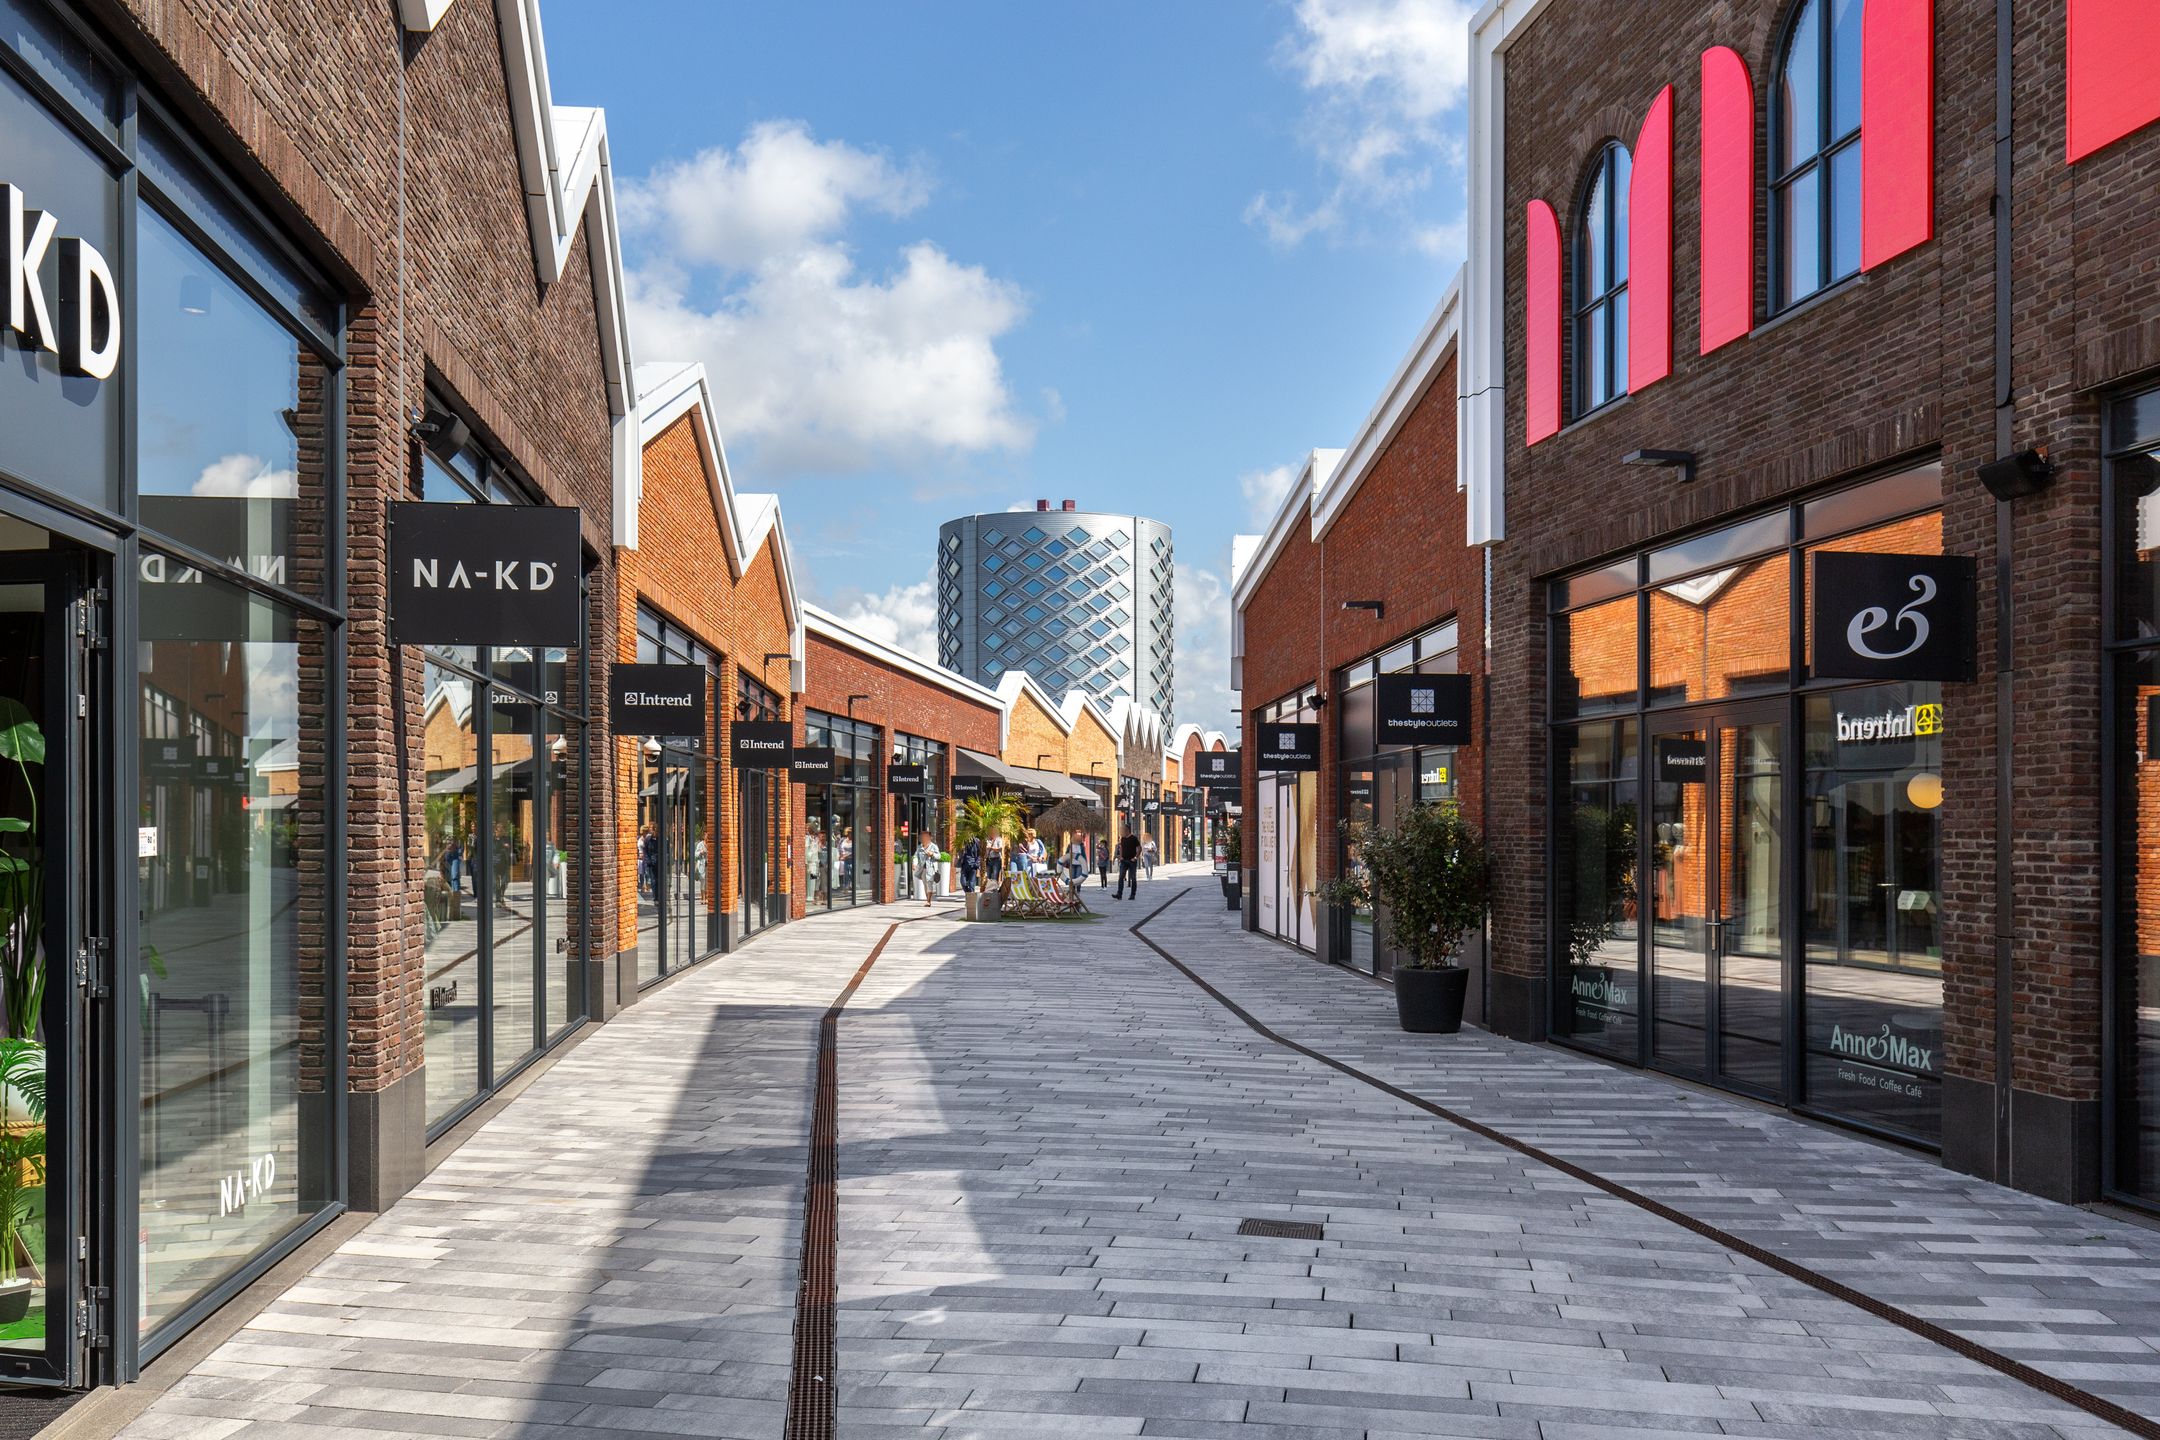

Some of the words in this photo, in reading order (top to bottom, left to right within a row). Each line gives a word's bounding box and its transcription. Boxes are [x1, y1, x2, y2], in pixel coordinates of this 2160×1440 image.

[413, 558, 557, 591] NA-KD
[639, 692, 692, 706] Intrend
[1388, 719, 1458, 729] thestyleoutlets
[750, 740, 785, 749] Intrend
[1838, 1068, 1856, 1083] Fresh
[1858, 1072, 1876, 1087] Food
[1879, 1078, 1902, 1093] Coffee
[1905, 1084, 1923, 1098] Café
[220, 1153, 276, 1218] NA-KD
